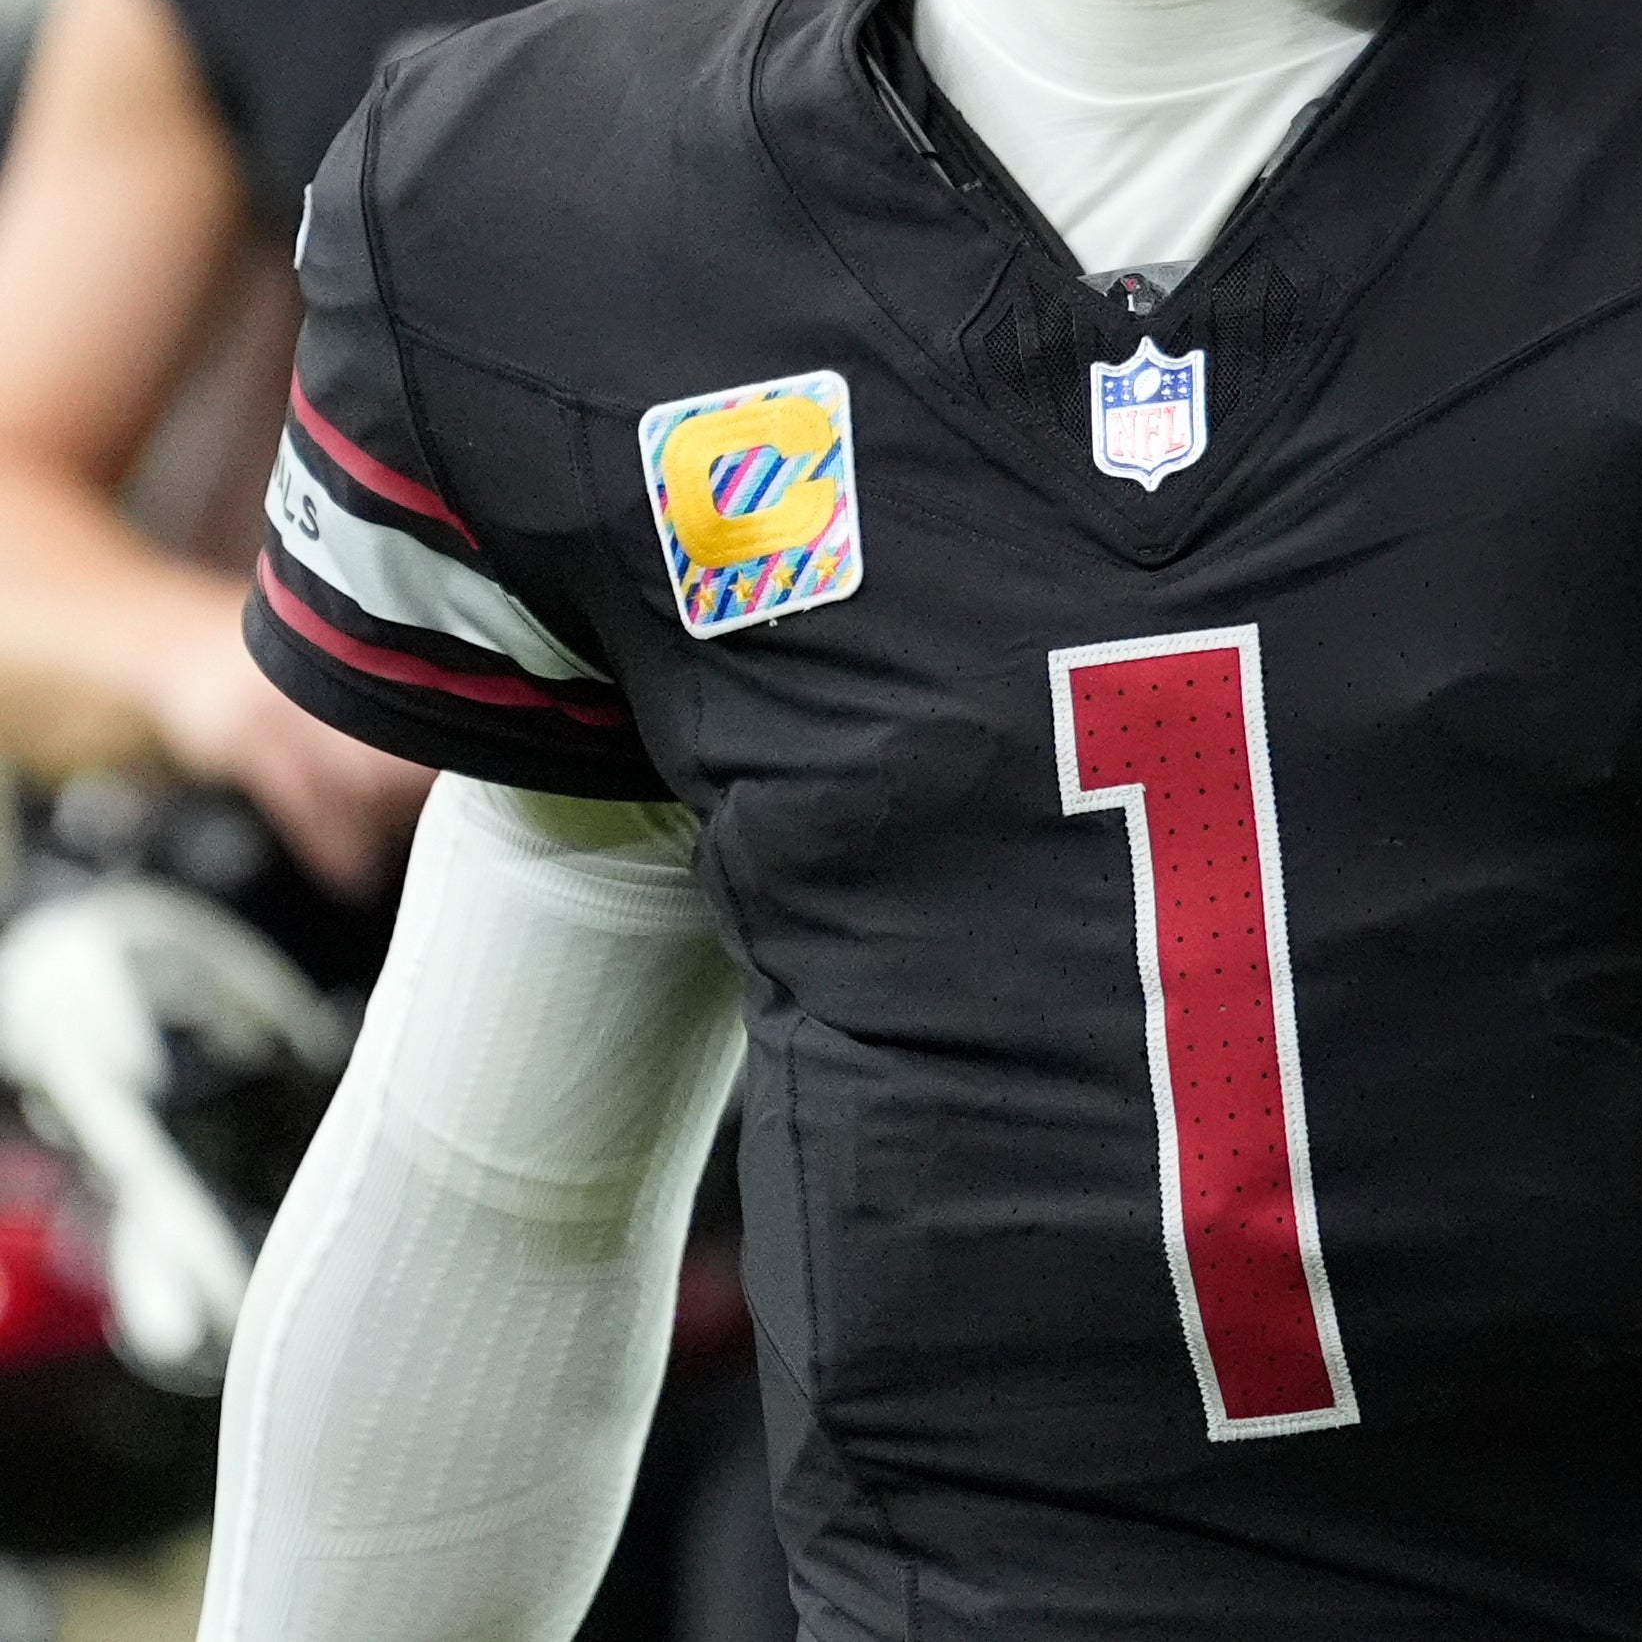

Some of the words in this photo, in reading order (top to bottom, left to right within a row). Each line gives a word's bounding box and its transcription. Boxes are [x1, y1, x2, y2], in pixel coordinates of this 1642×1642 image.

[661, 394, 838, 569] C
[1110, 404, 1186, 463] NFL
[1048, 623, 1361, 1443] 1
